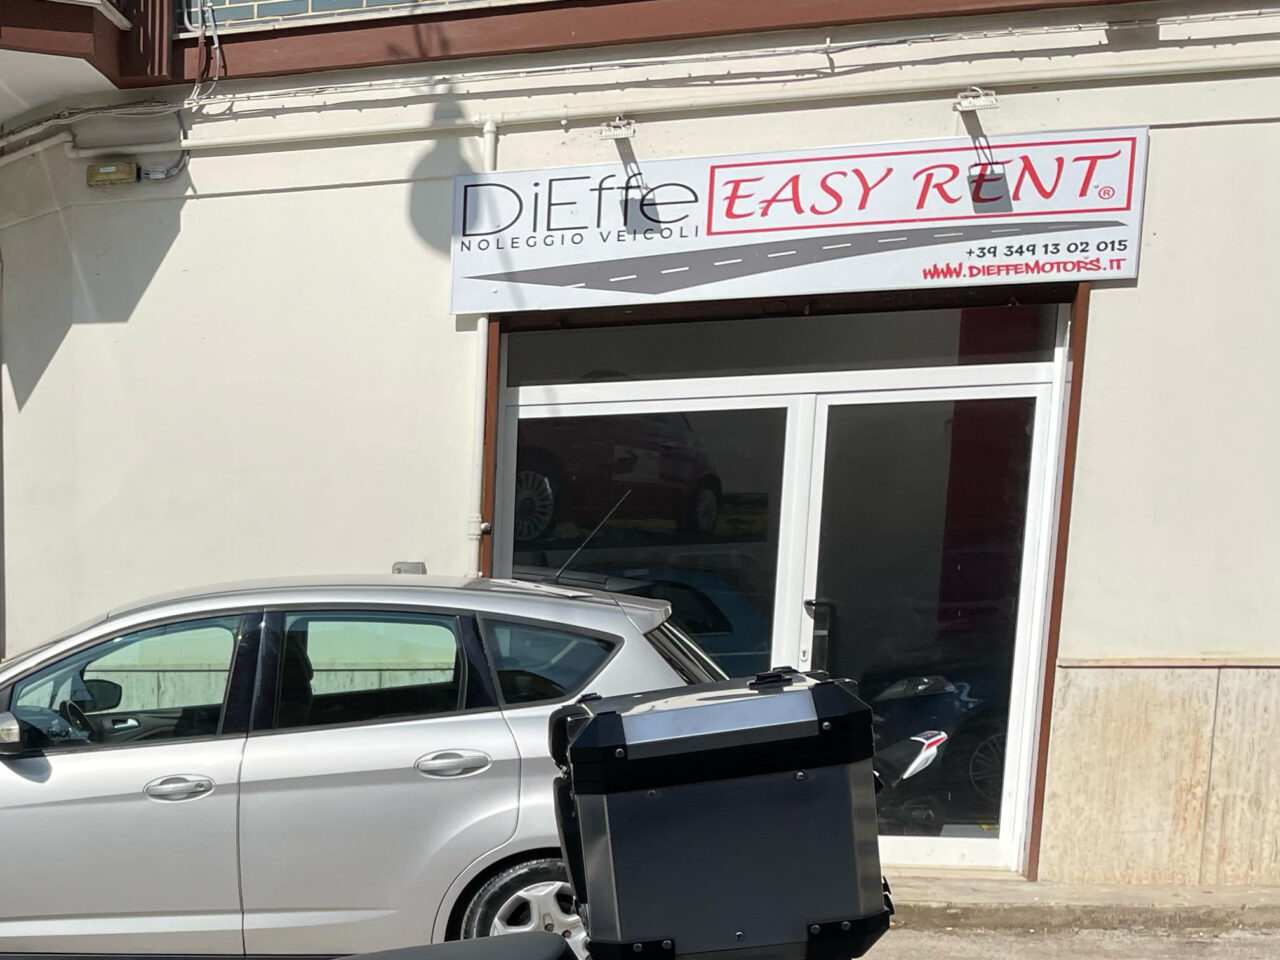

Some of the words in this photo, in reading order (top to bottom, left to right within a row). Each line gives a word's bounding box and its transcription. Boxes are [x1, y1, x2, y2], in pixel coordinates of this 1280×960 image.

[462, 172, 699, 237] DiEffe
[723, 167, 893, 219] EASY
[460, 233, 584, 252] NOLEGGIO
[599, 225, 699, 243] VEICOLI
[966, 245, 998, 259] +39
[1003, 244, 1036, 257] 349
[1042, 243, 1061, 255] 13
[1066, 241, 1090, 253] 02
[1095, 239, 1128, 252] 015
